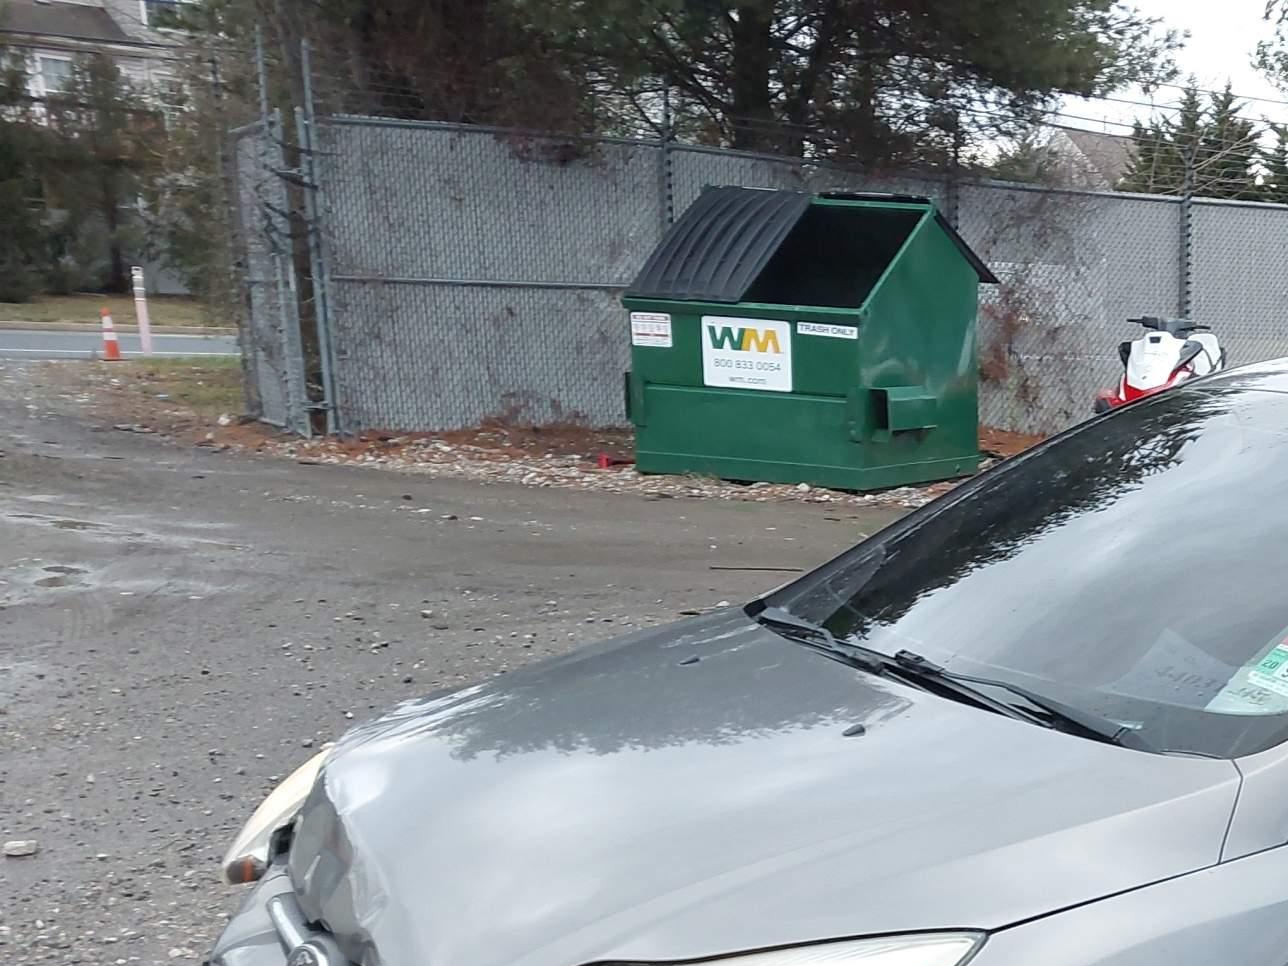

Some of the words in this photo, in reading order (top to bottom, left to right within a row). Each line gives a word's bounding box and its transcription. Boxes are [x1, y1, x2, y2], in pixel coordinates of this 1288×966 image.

[800, 323, 830, 335] TRASH
[831, 327, 855, 337] ONLY
[707, 325, 782, 354] WM
[713, 358, 733, 368] 800
[735, 360, 754, 370] 833
[755, 361, 782, 372] 0054
[728, 376, 768, 385] wm.com
